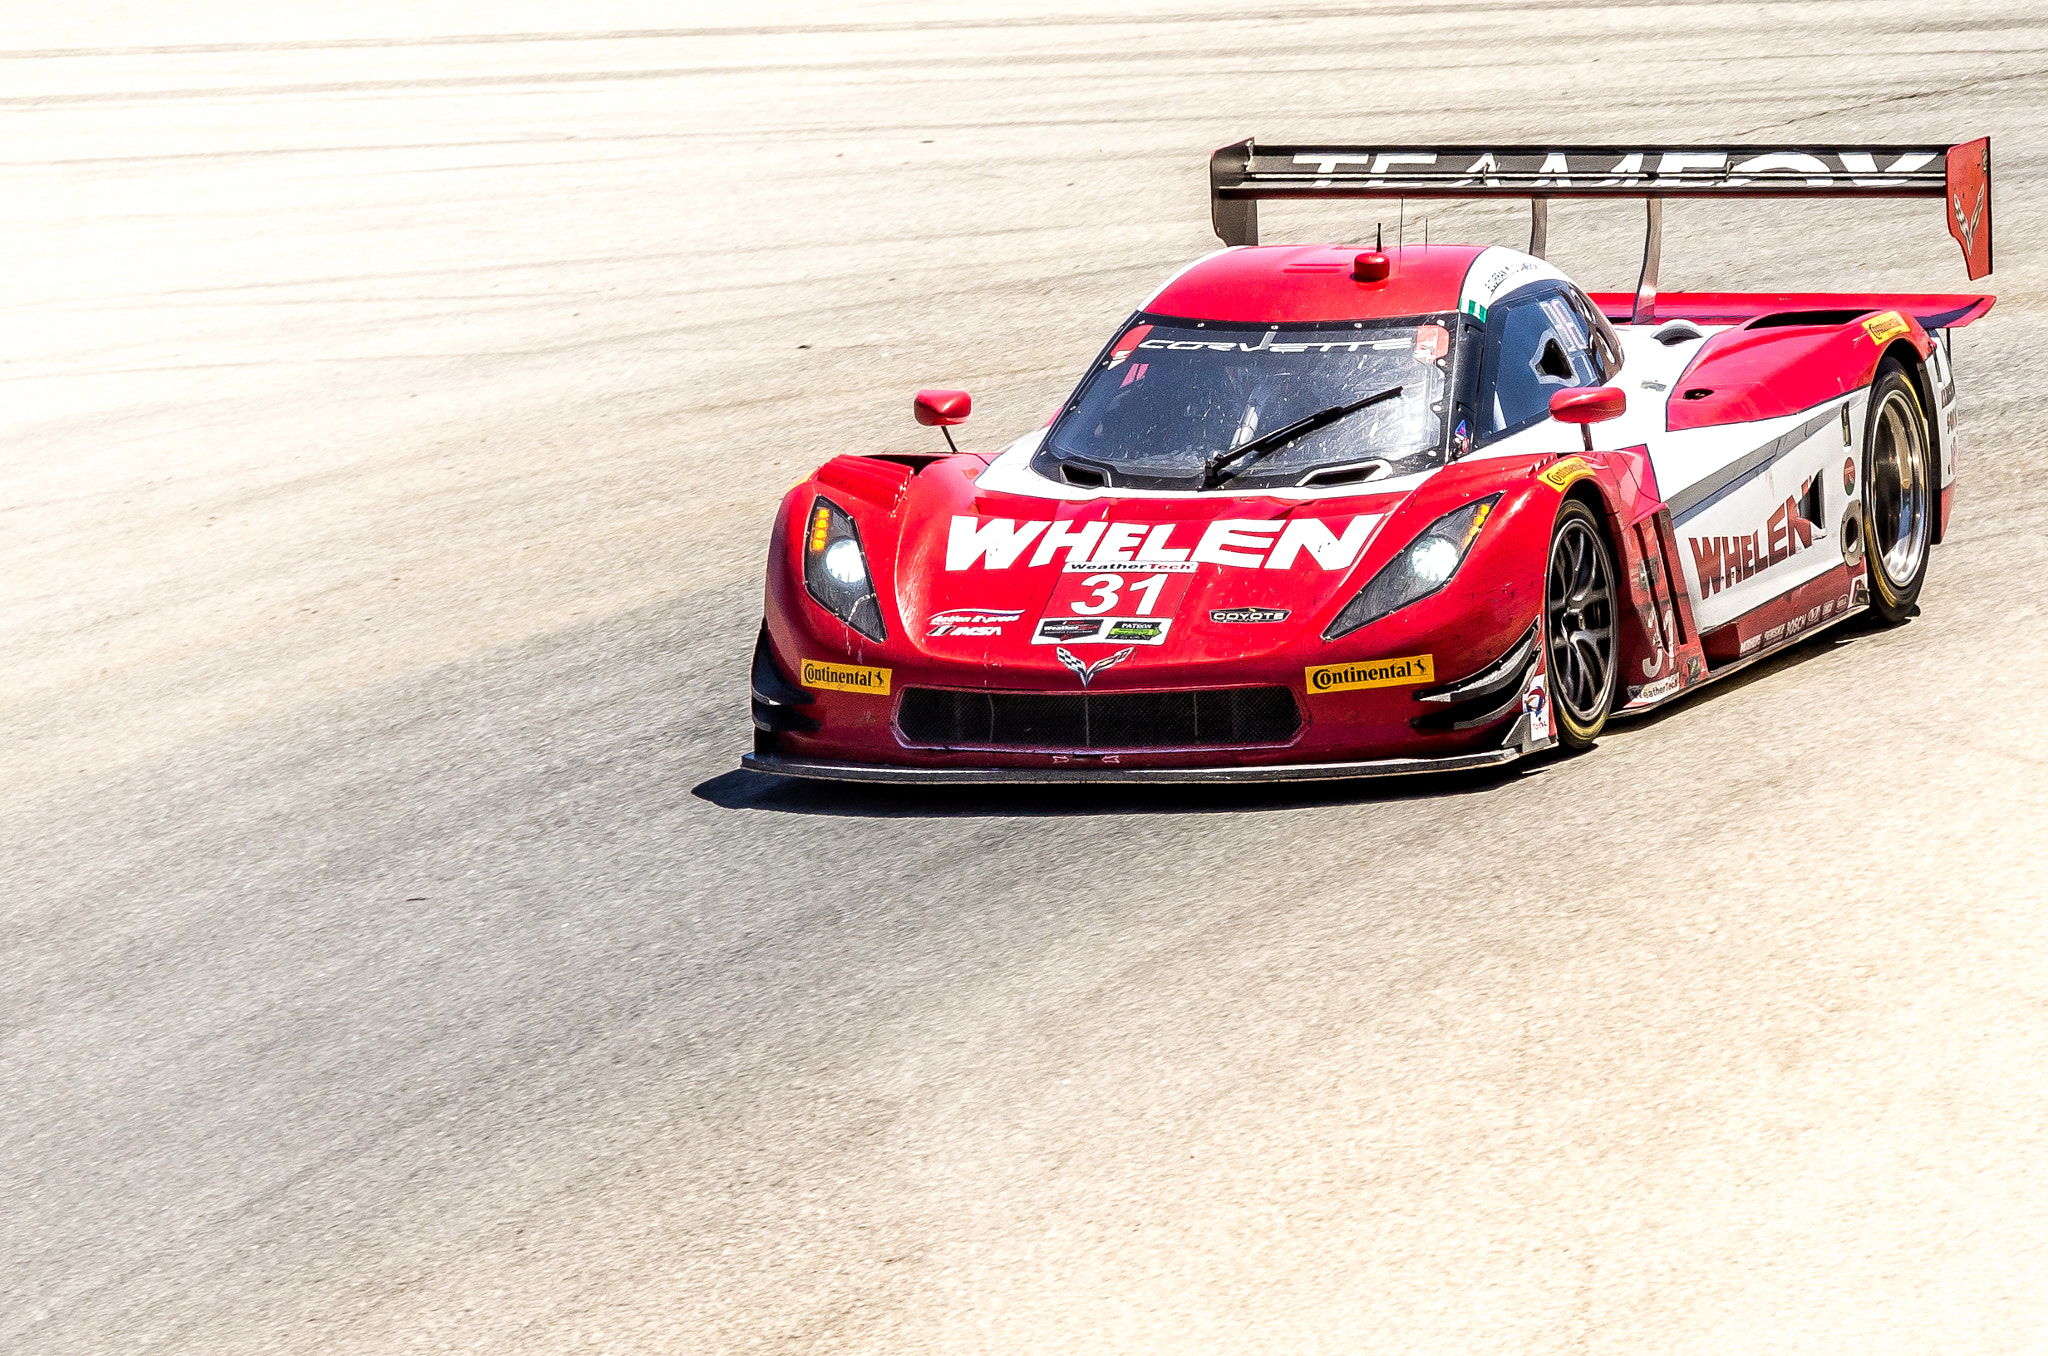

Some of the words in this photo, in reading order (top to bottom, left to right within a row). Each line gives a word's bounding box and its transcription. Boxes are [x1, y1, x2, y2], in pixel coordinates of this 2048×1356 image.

[945, 513, 1387, 571] WHELEN
[1071, 562, 1191, 571] WeatherTech
[1070, 573, 1168, 616] 31
[1213, 612, 1285, 621] COYOTE
[950, 626, 1001, 636] IMSA
[804, 663, 872, 687] Continental
[1312, 661, 1412, 690] Continental
